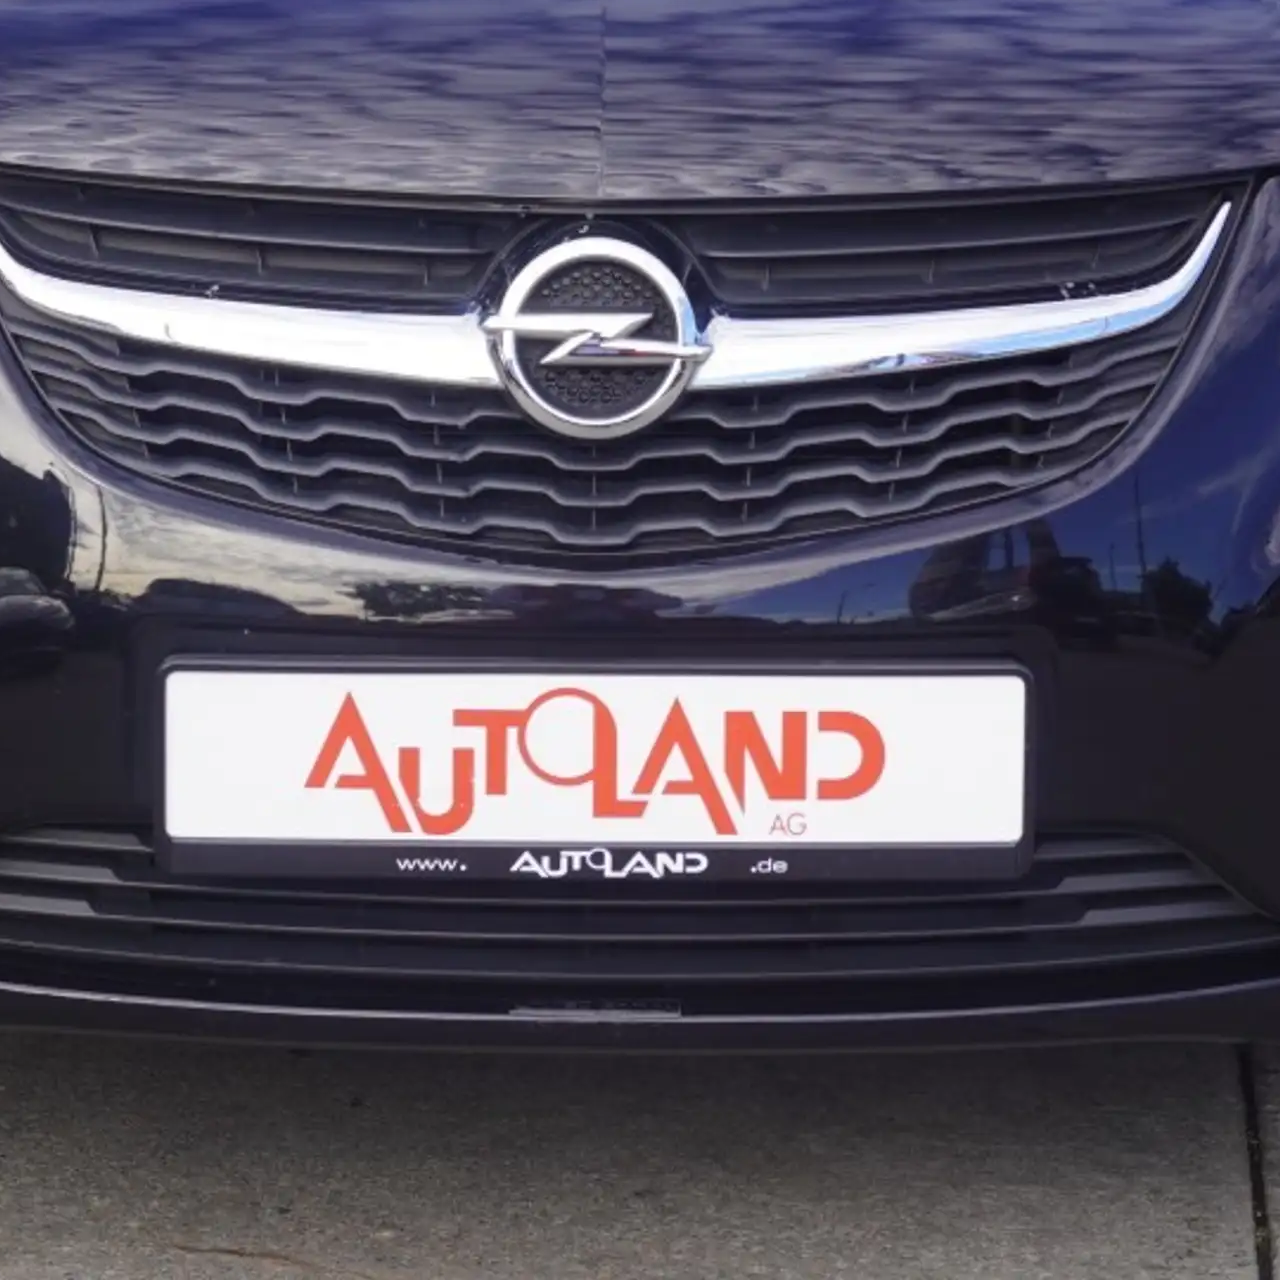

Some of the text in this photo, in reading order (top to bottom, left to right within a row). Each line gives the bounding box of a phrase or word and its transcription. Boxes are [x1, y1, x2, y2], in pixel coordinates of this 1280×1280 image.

[304, 687, 886, 835] AUTOLAND
[769, 813, 808, 836] AG
[396, 847, 789, 879] www. AUTOLAND .de
